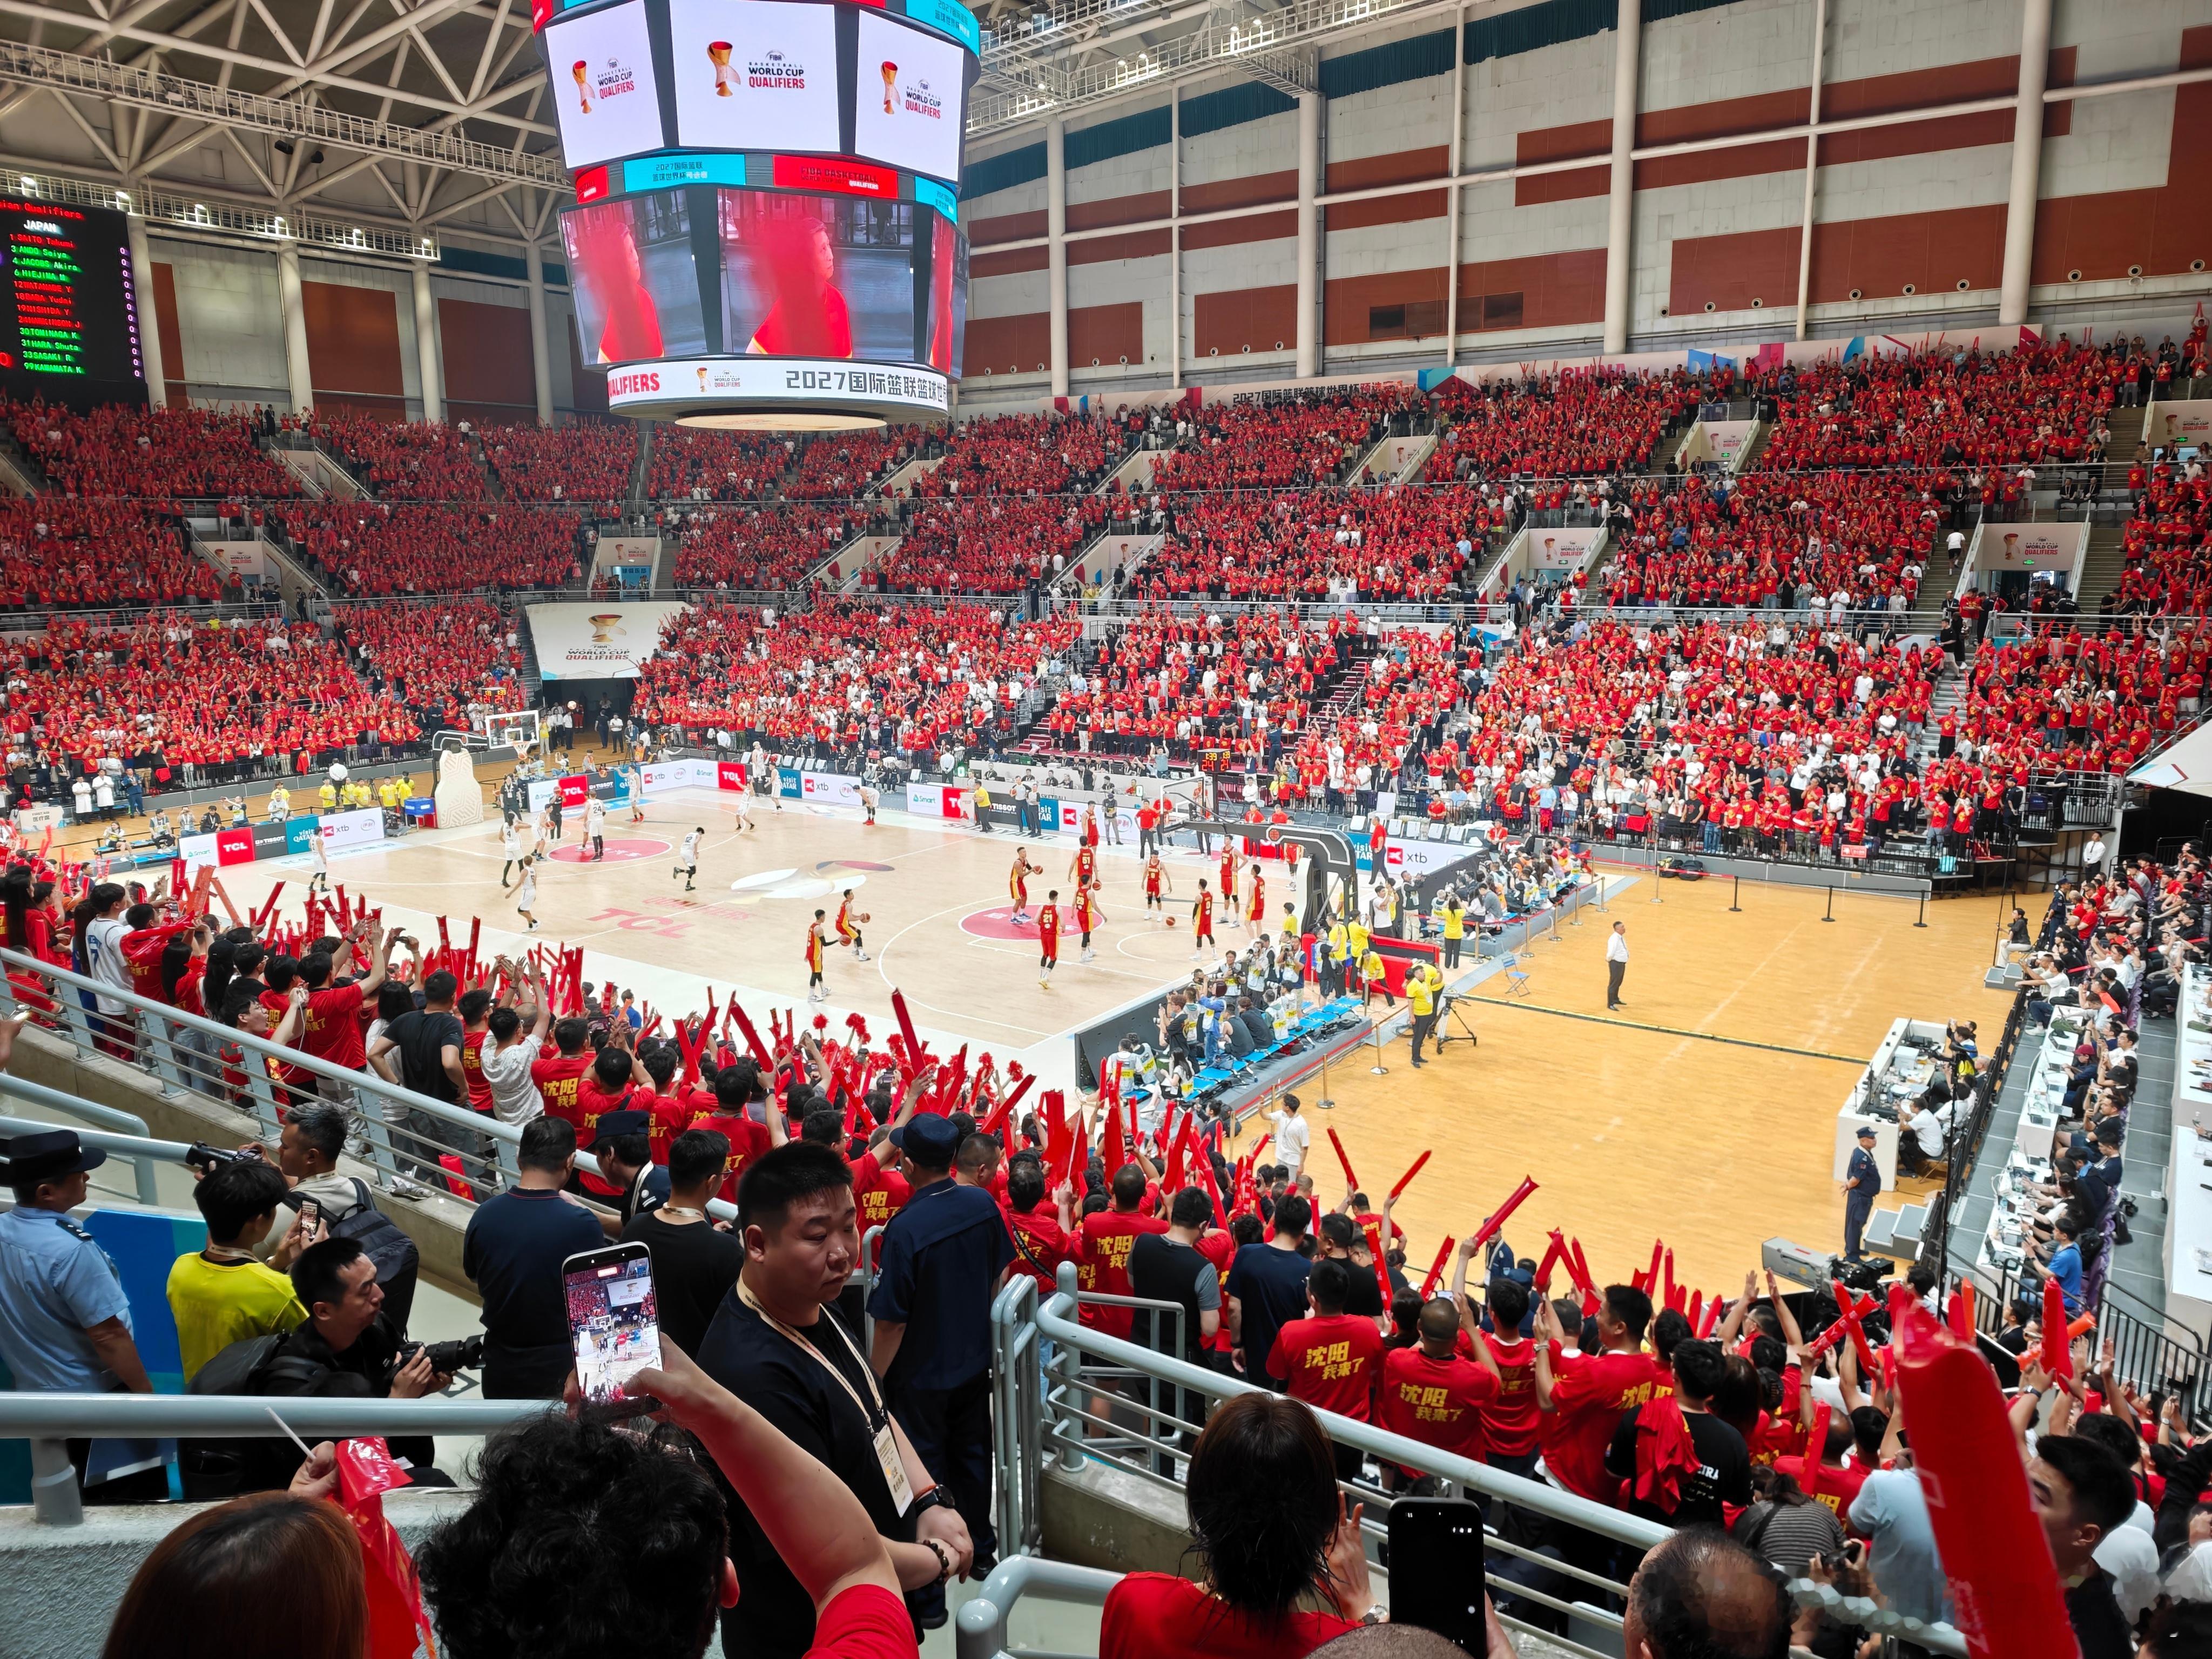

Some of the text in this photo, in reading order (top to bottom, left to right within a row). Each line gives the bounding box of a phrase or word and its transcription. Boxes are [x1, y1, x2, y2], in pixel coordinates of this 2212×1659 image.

[598, 66, 631, 78] BASKETBALL
[748, 67, 804, 77] WORLD CUP
[598, 71, 632, 86] WORLD CUP
[748, 77, 805, 89] QUALIFIERS
[599, 81, 635, 99] QUALIFIERS
[906, 91, 941, 107] WORLD CUP
[906, 99, 941, 119] QUALIFIERS
[825, 168, 878, 183] BASKETBALL
[849, 180, 879, 190] QUALIFIERS
[24, 203, 82, 219] Qualifiers
[24, 220, 57, 233] JAPAN
[19, 246, 39, 255] ANDO
[21, 258, 50, 267] JACOBS
[55, 342, 78, 351] Shuta
[1561, 363, 1626, 383] CHNA
[1202, 760, 1214, 771] 24
[722, 771, 741, 781] TCL
[564, 786, 583, 796] TCL
[816, 783, 828, 791] xtb
[919, 795, 935, 804] Smart
[593, 806, 602, 814] 24
[992, 803, 1016, 812] TISSOT
[1038, 804, 1051, 813] isit
[1038, 813, 1052, 821] TAR
[224, 842, 248, 852] TCL
[1355, 851, 1373, 860] TAR
[1406, 852, 1427, 863] xtb
[587, 908, 695, 939] TCL
[1043, 914, 1053, 923] 21
[543, 1077, 578, 1097] 沈阳
[557, 1094, 578, 1108] 我来
[584, 1113, 597, 1128] 沈
[692, 1110, 711, 1123] 沈
[650, 1127, 667, 1138] 来了
[1097, 1235, 1133, 1255] 沈阳
[1305, 1341, 1350, 1369] 沈阳
[1322, 1357, 1365, 1380] 我来了
[1501, 1367, 1518, 1379] 阳
[1400, 1382, 1449, 1407] 沈阳
[1415, 1406, 1464, 1422] 我来了
[1816, 1493, 1841, 1514] 阳
